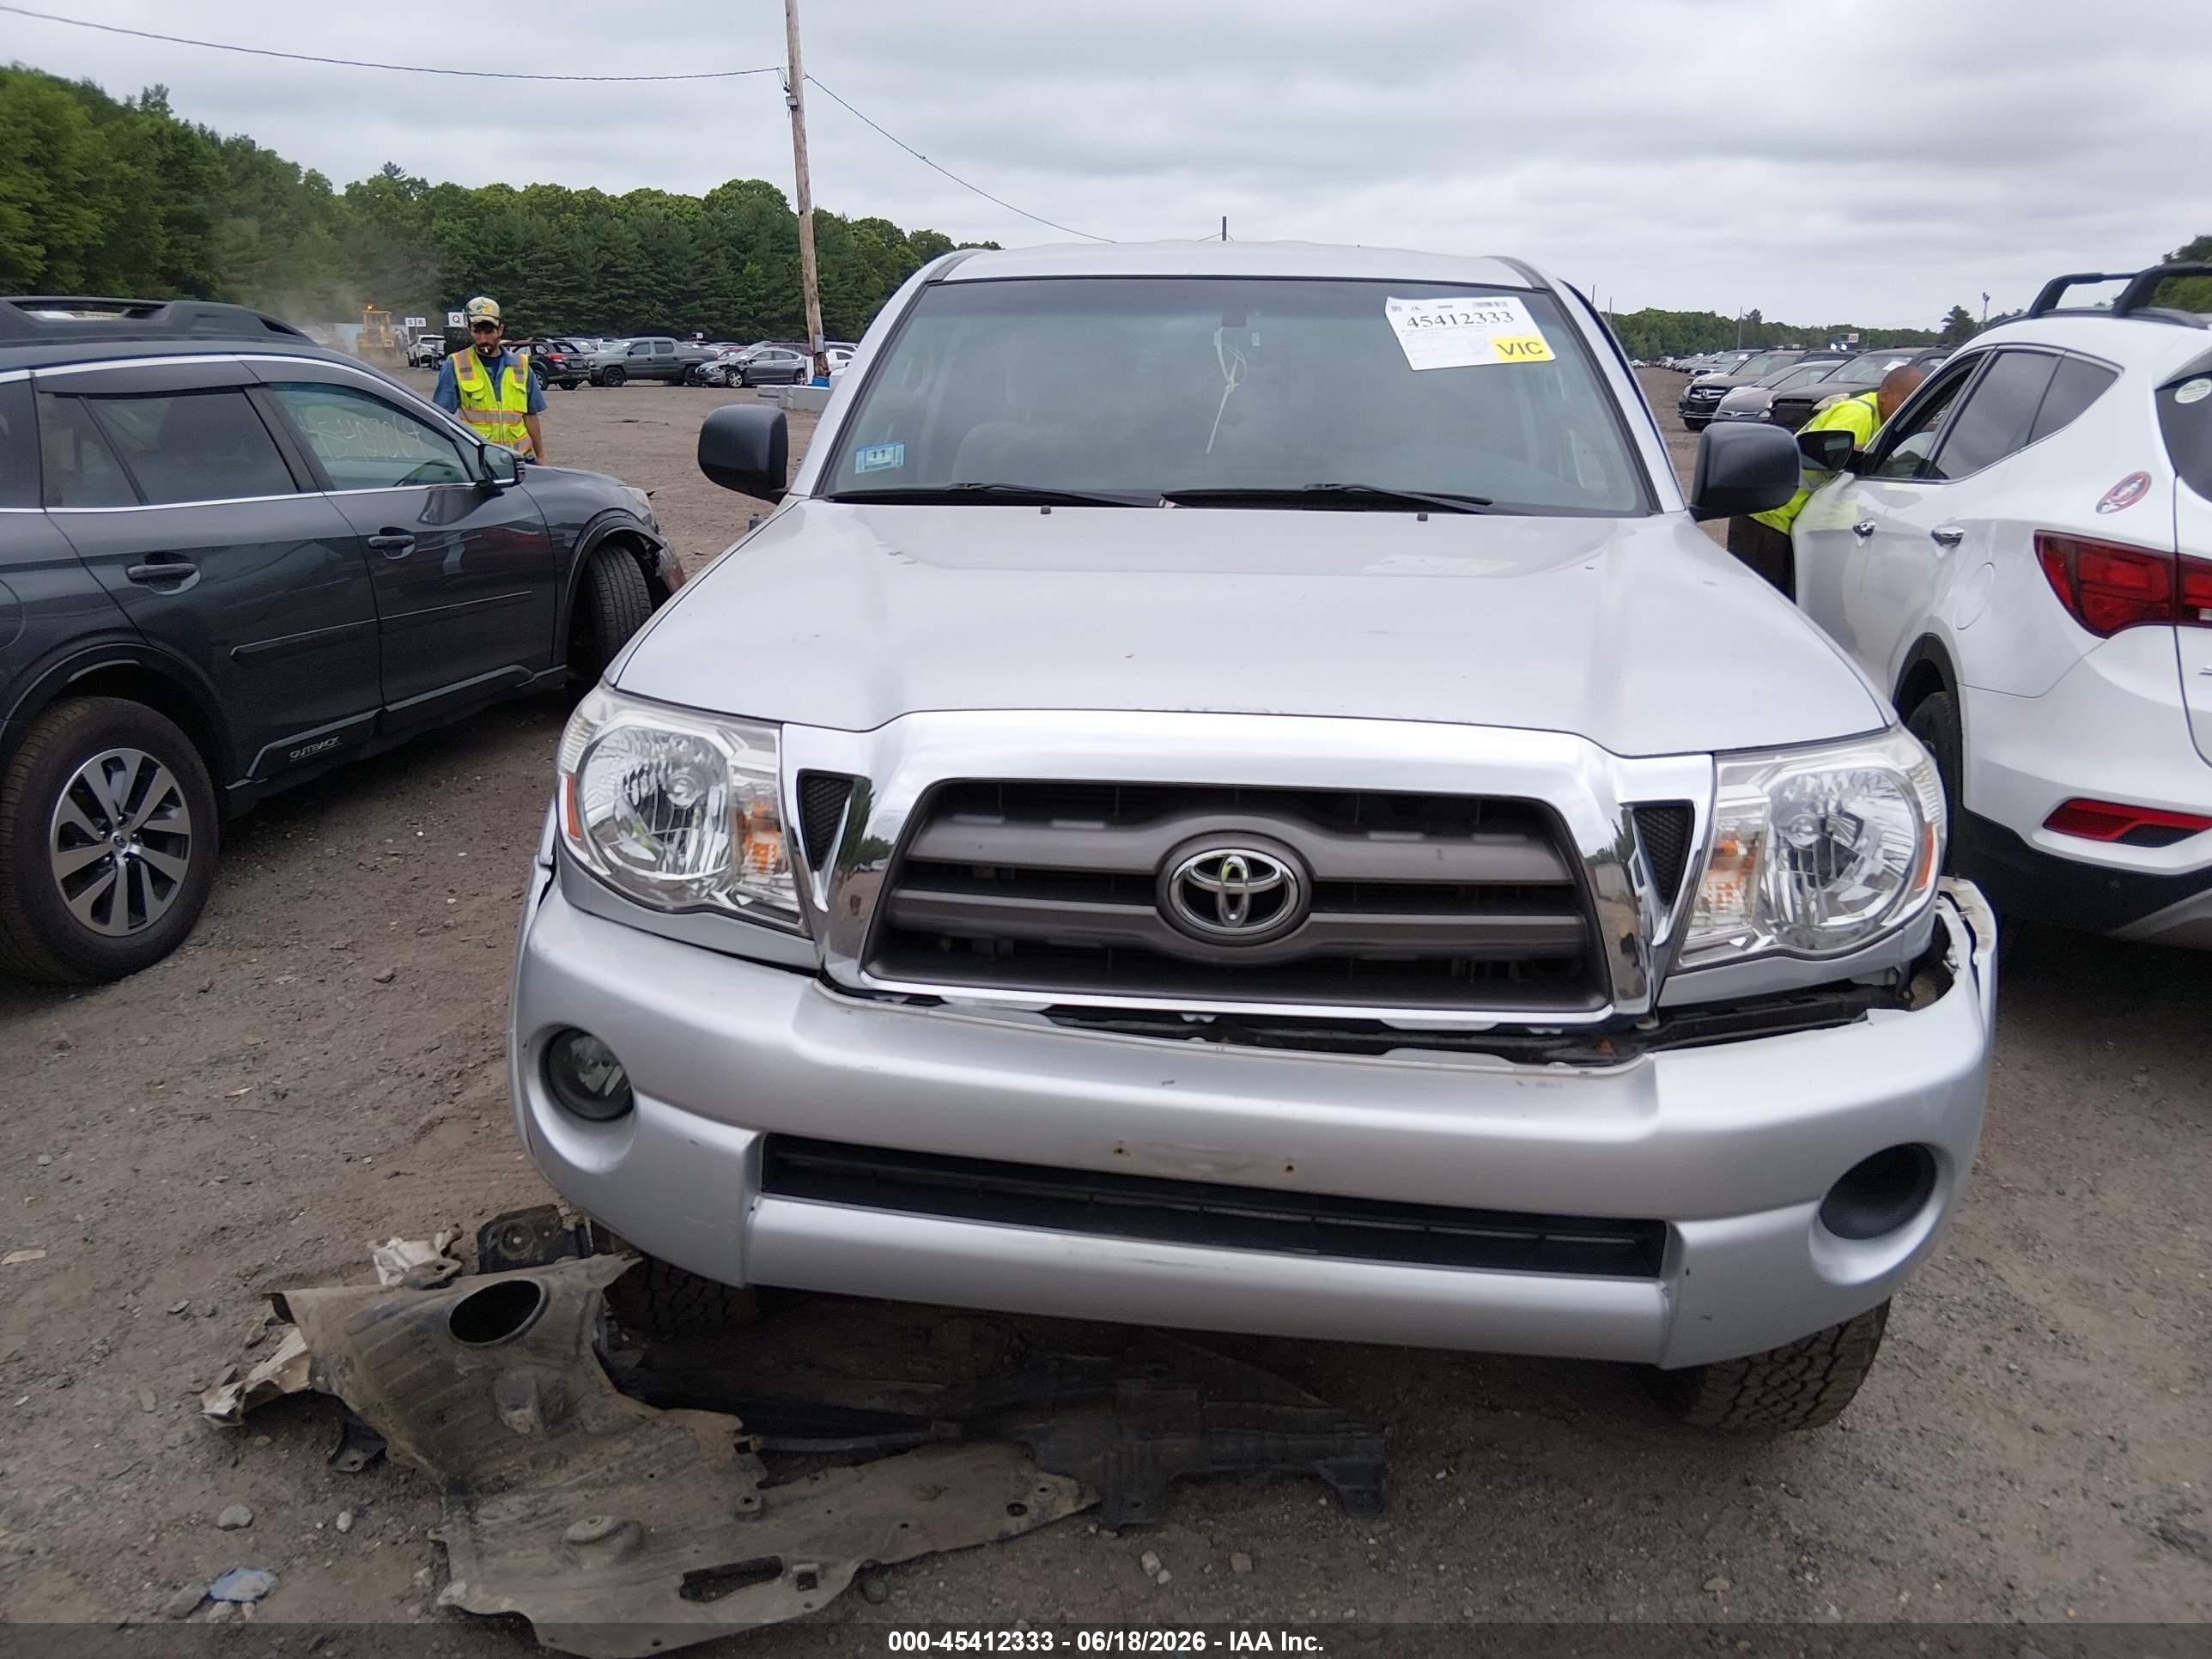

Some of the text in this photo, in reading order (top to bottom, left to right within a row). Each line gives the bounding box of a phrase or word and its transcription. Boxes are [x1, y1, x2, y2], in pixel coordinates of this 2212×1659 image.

[452, 314, 461, 325] Q
[1406, 311, 1515, 328] 45412333
[1498, 342, 1543, 356] VIC
